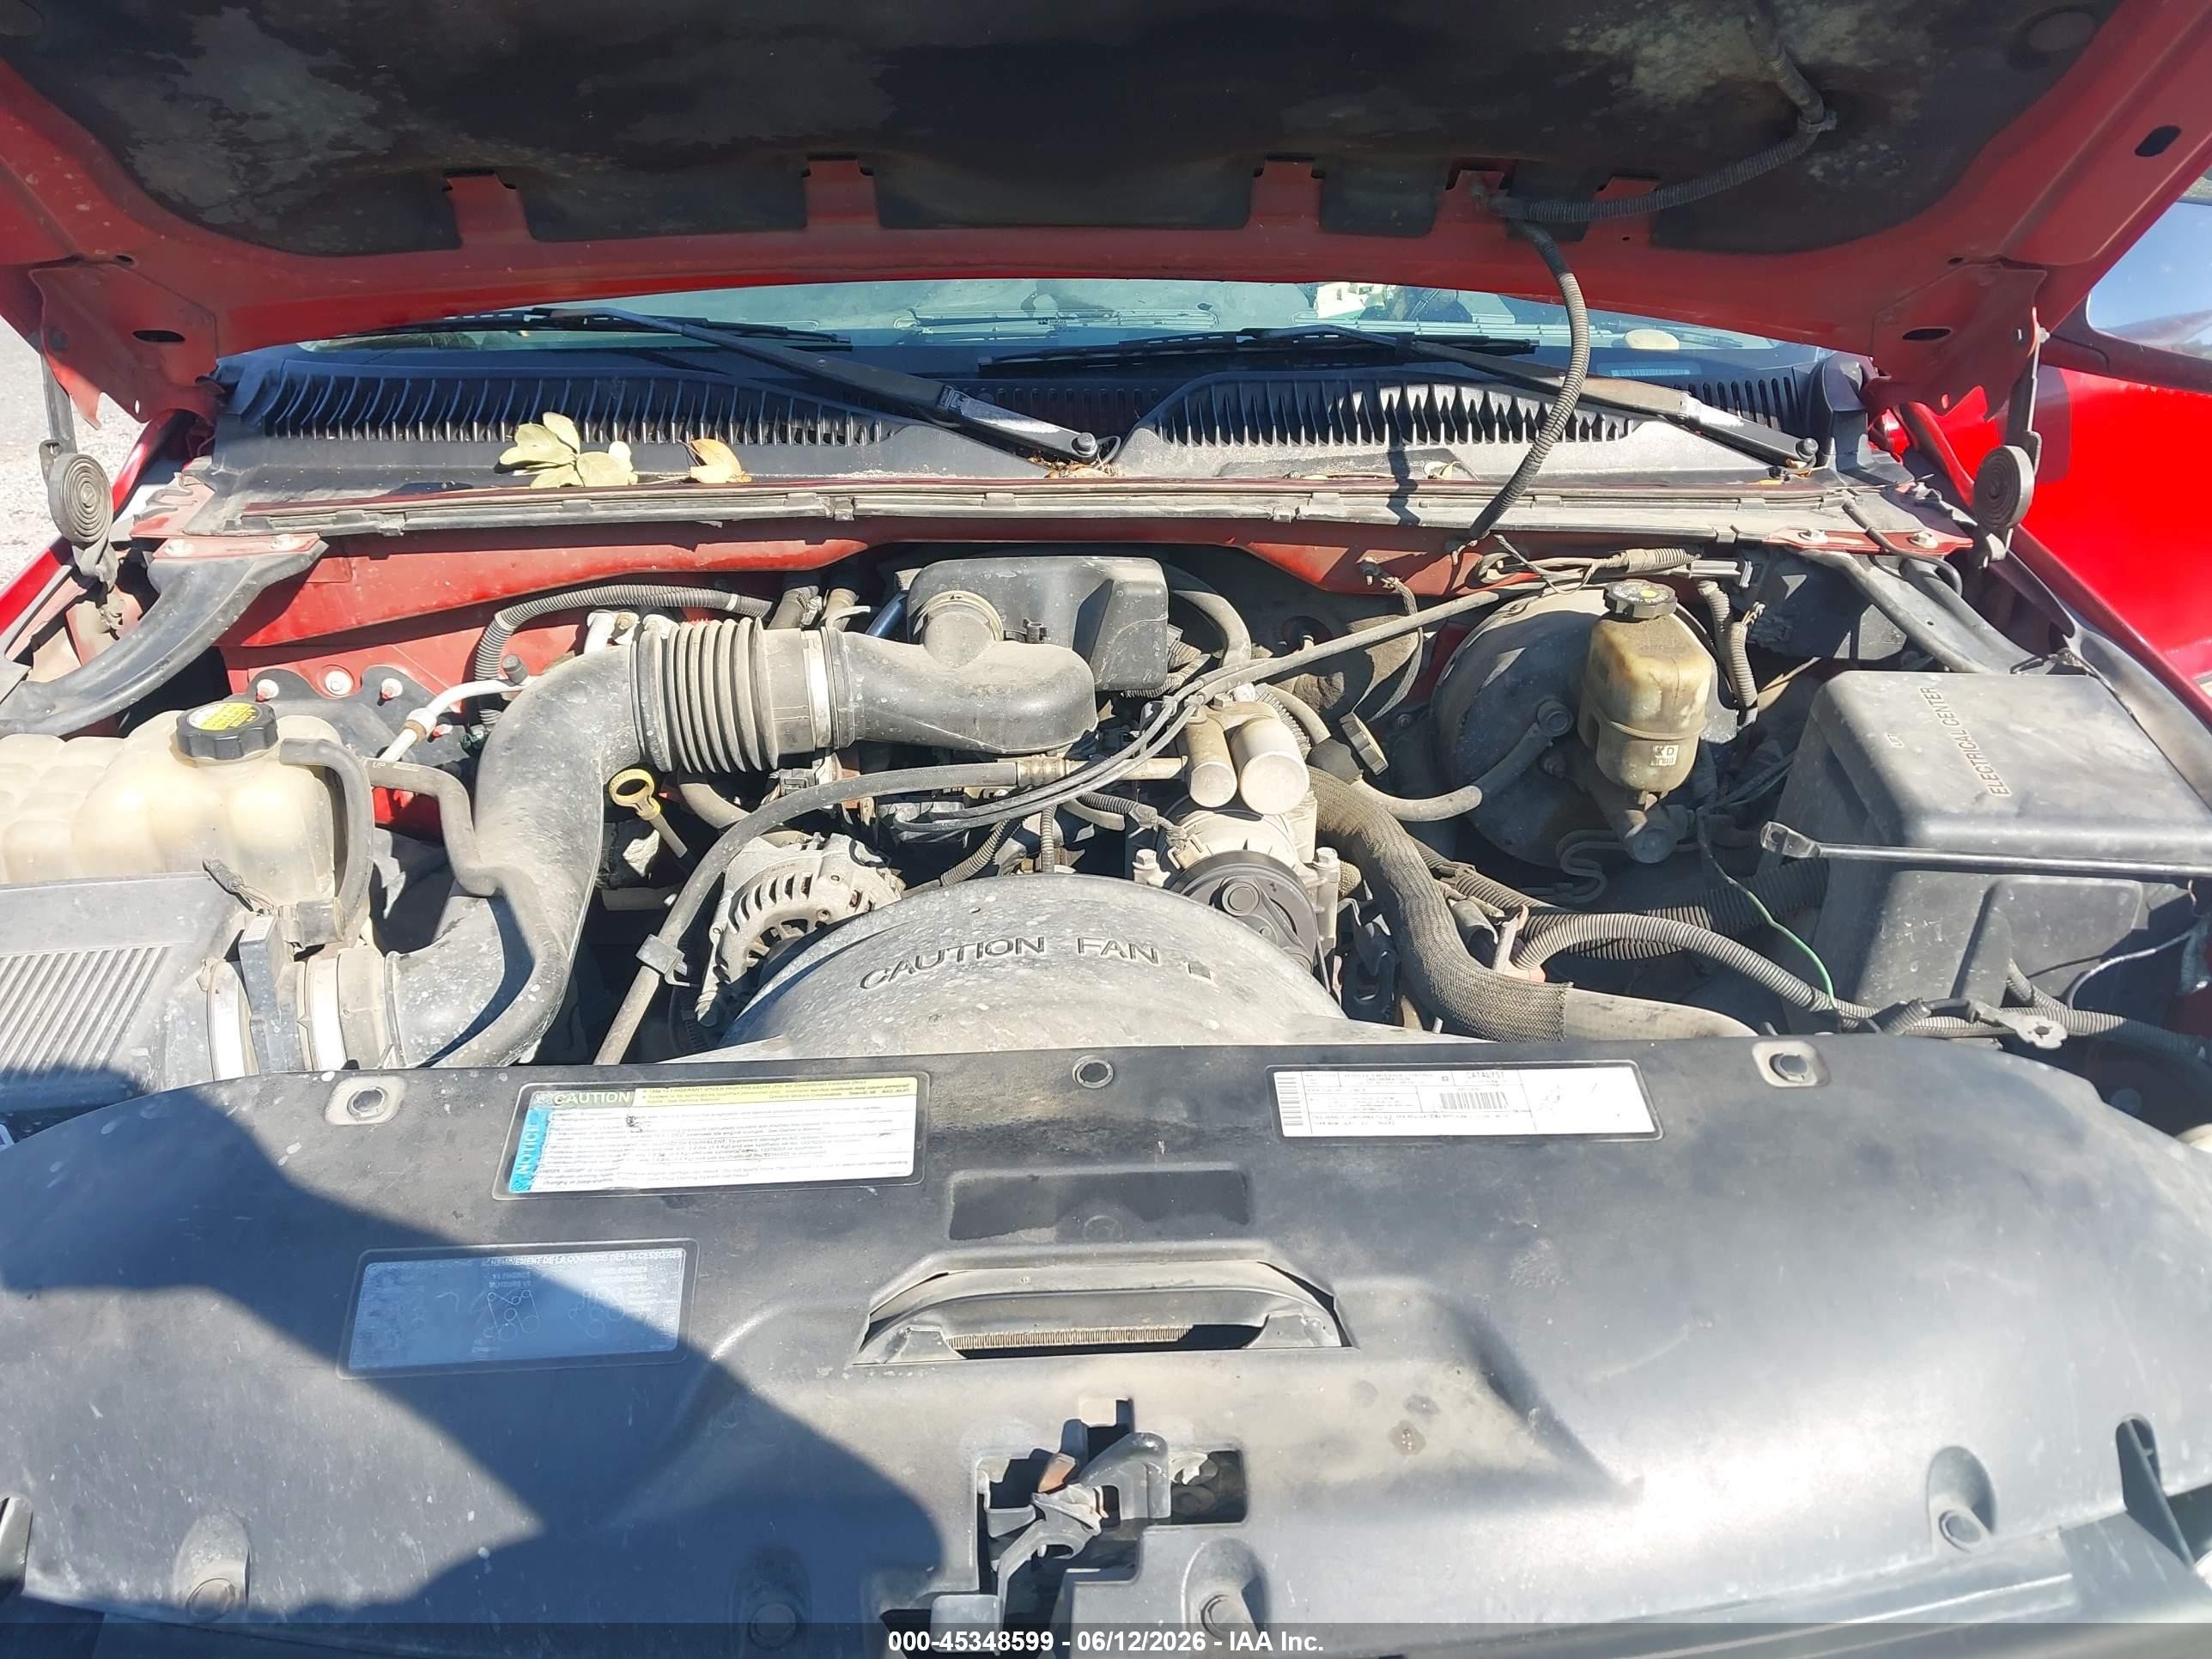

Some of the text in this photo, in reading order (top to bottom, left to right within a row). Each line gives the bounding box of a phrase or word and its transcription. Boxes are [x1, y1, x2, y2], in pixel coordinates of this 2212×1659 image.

[1921, 686, 2011, 796] ELECTRICAL CENTER
[860, 936, 1159, 990] CAUTION FAN
[554, 1091, 630, 1105] CAUTION
